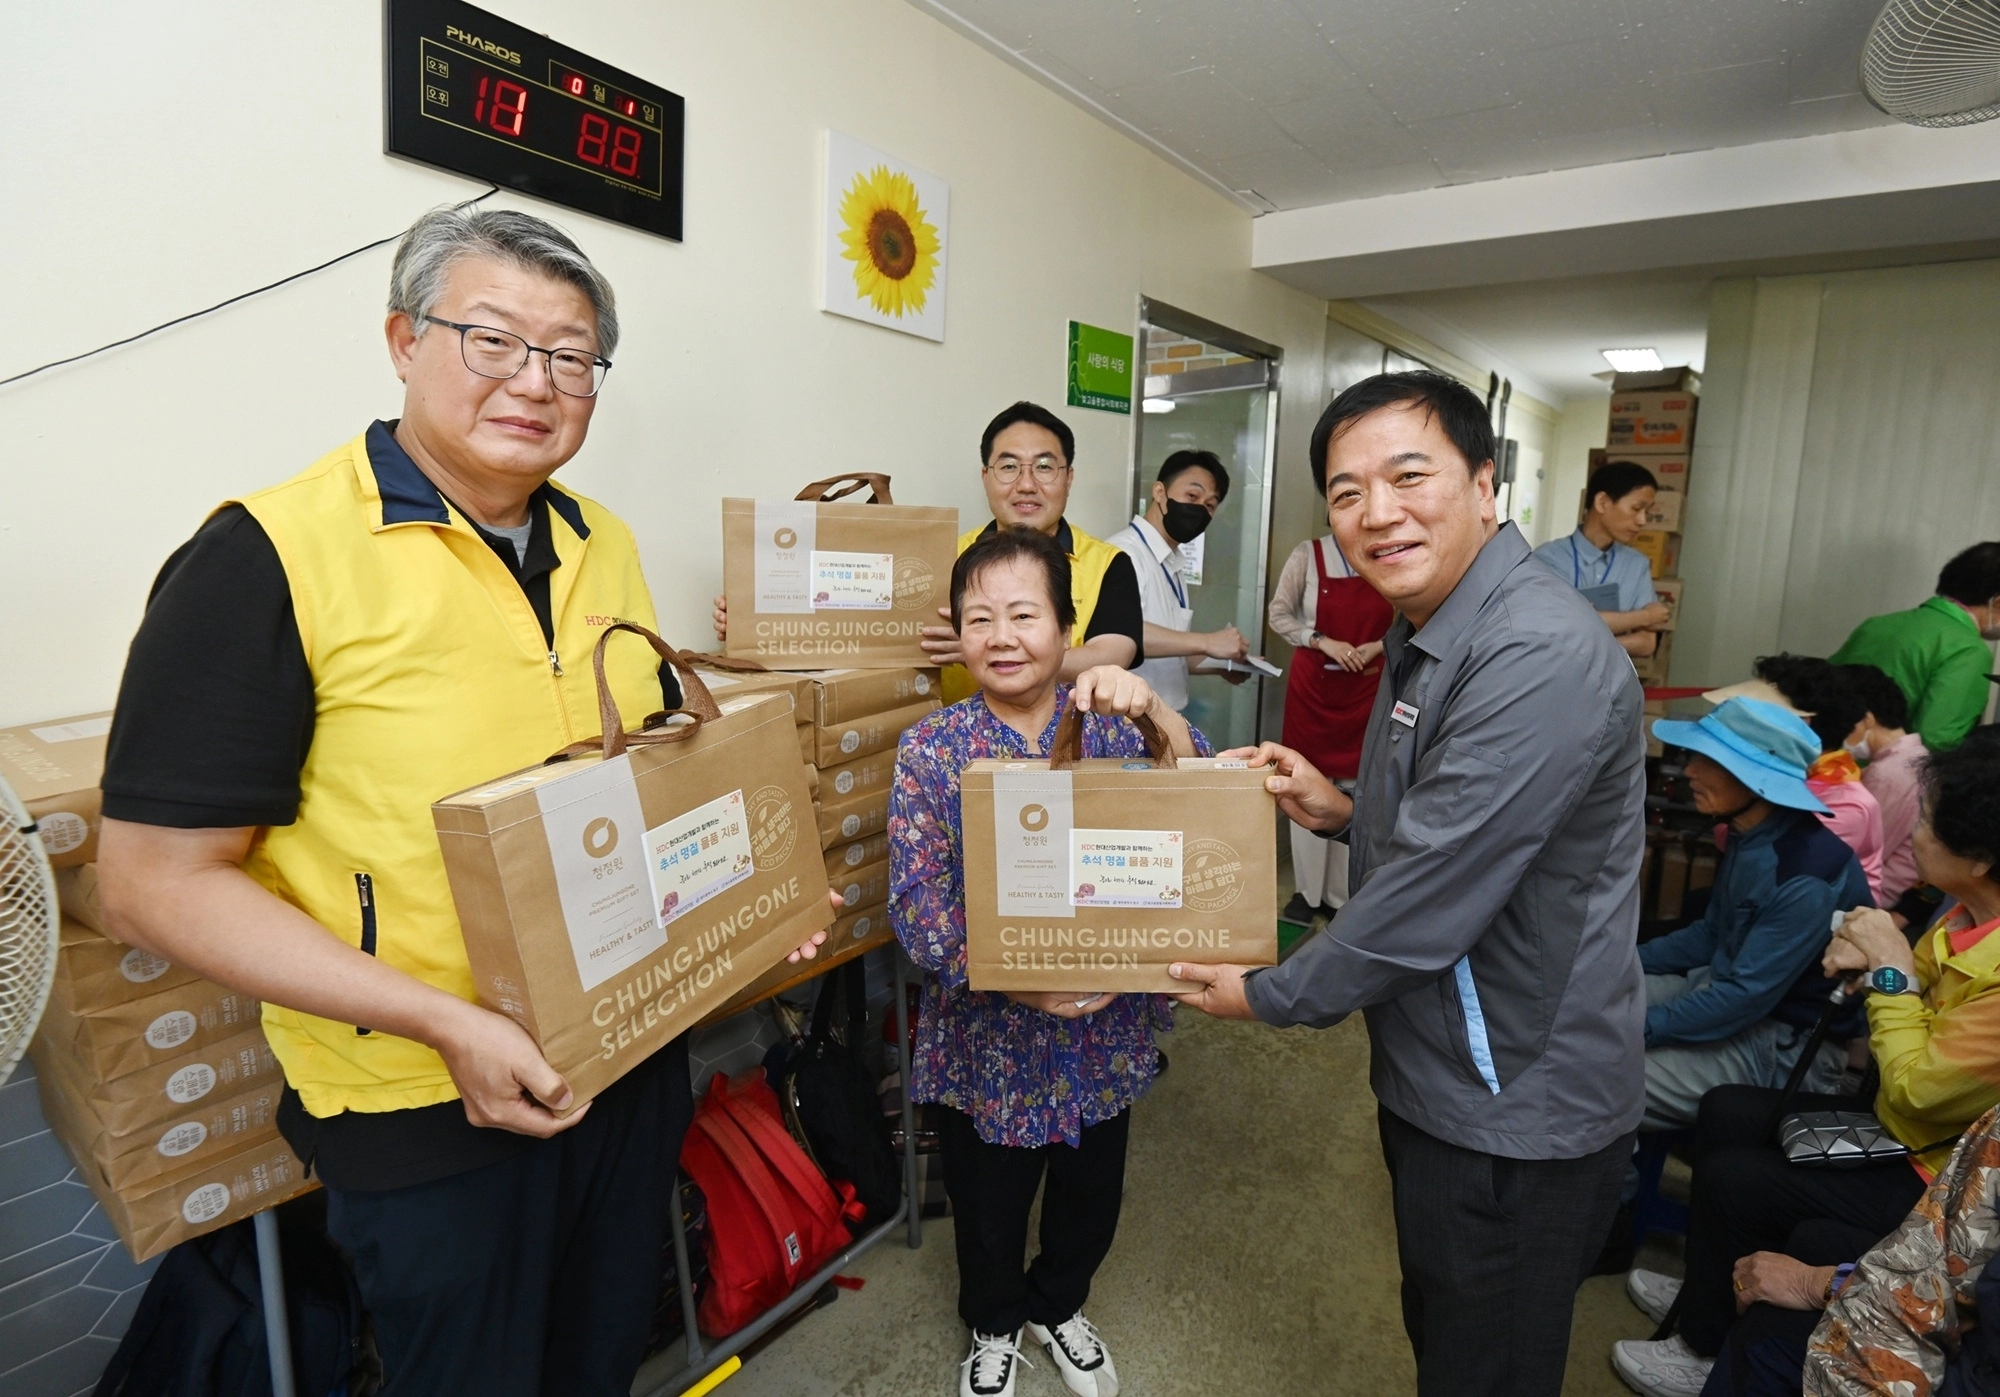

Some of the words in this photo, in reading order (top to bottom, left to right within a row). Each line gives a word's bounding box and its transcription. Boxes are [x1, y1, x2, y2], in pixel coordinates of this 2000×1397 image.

[446, 25, 522, 65] PHAROS
[428, 59, 448, 76] 오전
[428, 88, 448, 105] 오후
[1088, 353, 1110, 370] 사랑의
[1111, 358, 1125, 374] 식당
[819, 570, 835, 578] 추석
[837, 571, 852, 580] 명절
[854, 571, 869, 580] 물품
[871, 572, 886, 581] 지원
[585, 615, 612, 626] HDC
[755, 620, 925, 637] CHUNGJUNGONE
[756, 639, 860, 655] SELECTION
[755, 790, 768, 803] AND
[768, 789, 783, 799] TASTY
[659, 852, 679, 871] 추석
[680, 841, 700, 861] 명절
[700, 832, 719, 851] 물품
[721, 821, 740, 839] 지원
[760, 858, 775, 867] ECO
[775, 830, 795, 863] PACKAGE
[1022, 835, 1048, 847] 청정원
[1196, 842, 1212, 850] AND
[1212, 843, 1233, 857] TASTY
[592, 856, 624, 880] 청정원
[1081, 854, 1102, 866] 추석
[1105, 855, 1126, 867] 명절
[1129, 856, 1149, 867] 물품
[1152, 856, 1173, 868] 지원
[589, 901, 616, 917] PREMIUM
[630, 888, 640, 898] SET
[1008, 891, 1037, 899] HEALTHY
[1189, 898, 1206, 909] ECO
[1207, 887, 1239, 909] PACKAGE
[589, 935, 624, 960] HEALTHY
[626, 932, 633, 941] &
[634, 918, 655, 936] TASTY
[999, 926, 1231, 949] CHUNGJUNGONE
[591, 876, 801, 1028] CHUNGJUNGONE
[1001, 951, 1139, 971] SELECTION
[1885, 969, 1894, 991] 11:39
[221, 997, 230, 1013] SOY
[599, 949, 734, 1061] SELECTION
[223, 1012, 232, 1025] INK
[240, 1050, 249, 1064] SOY
[242, 1065, 251, 1078] INK
[231, 1107, 240, 1121] SOY
[233, 1121, 241, 1133] INK
[254, 1179, 264, 1193] INK
